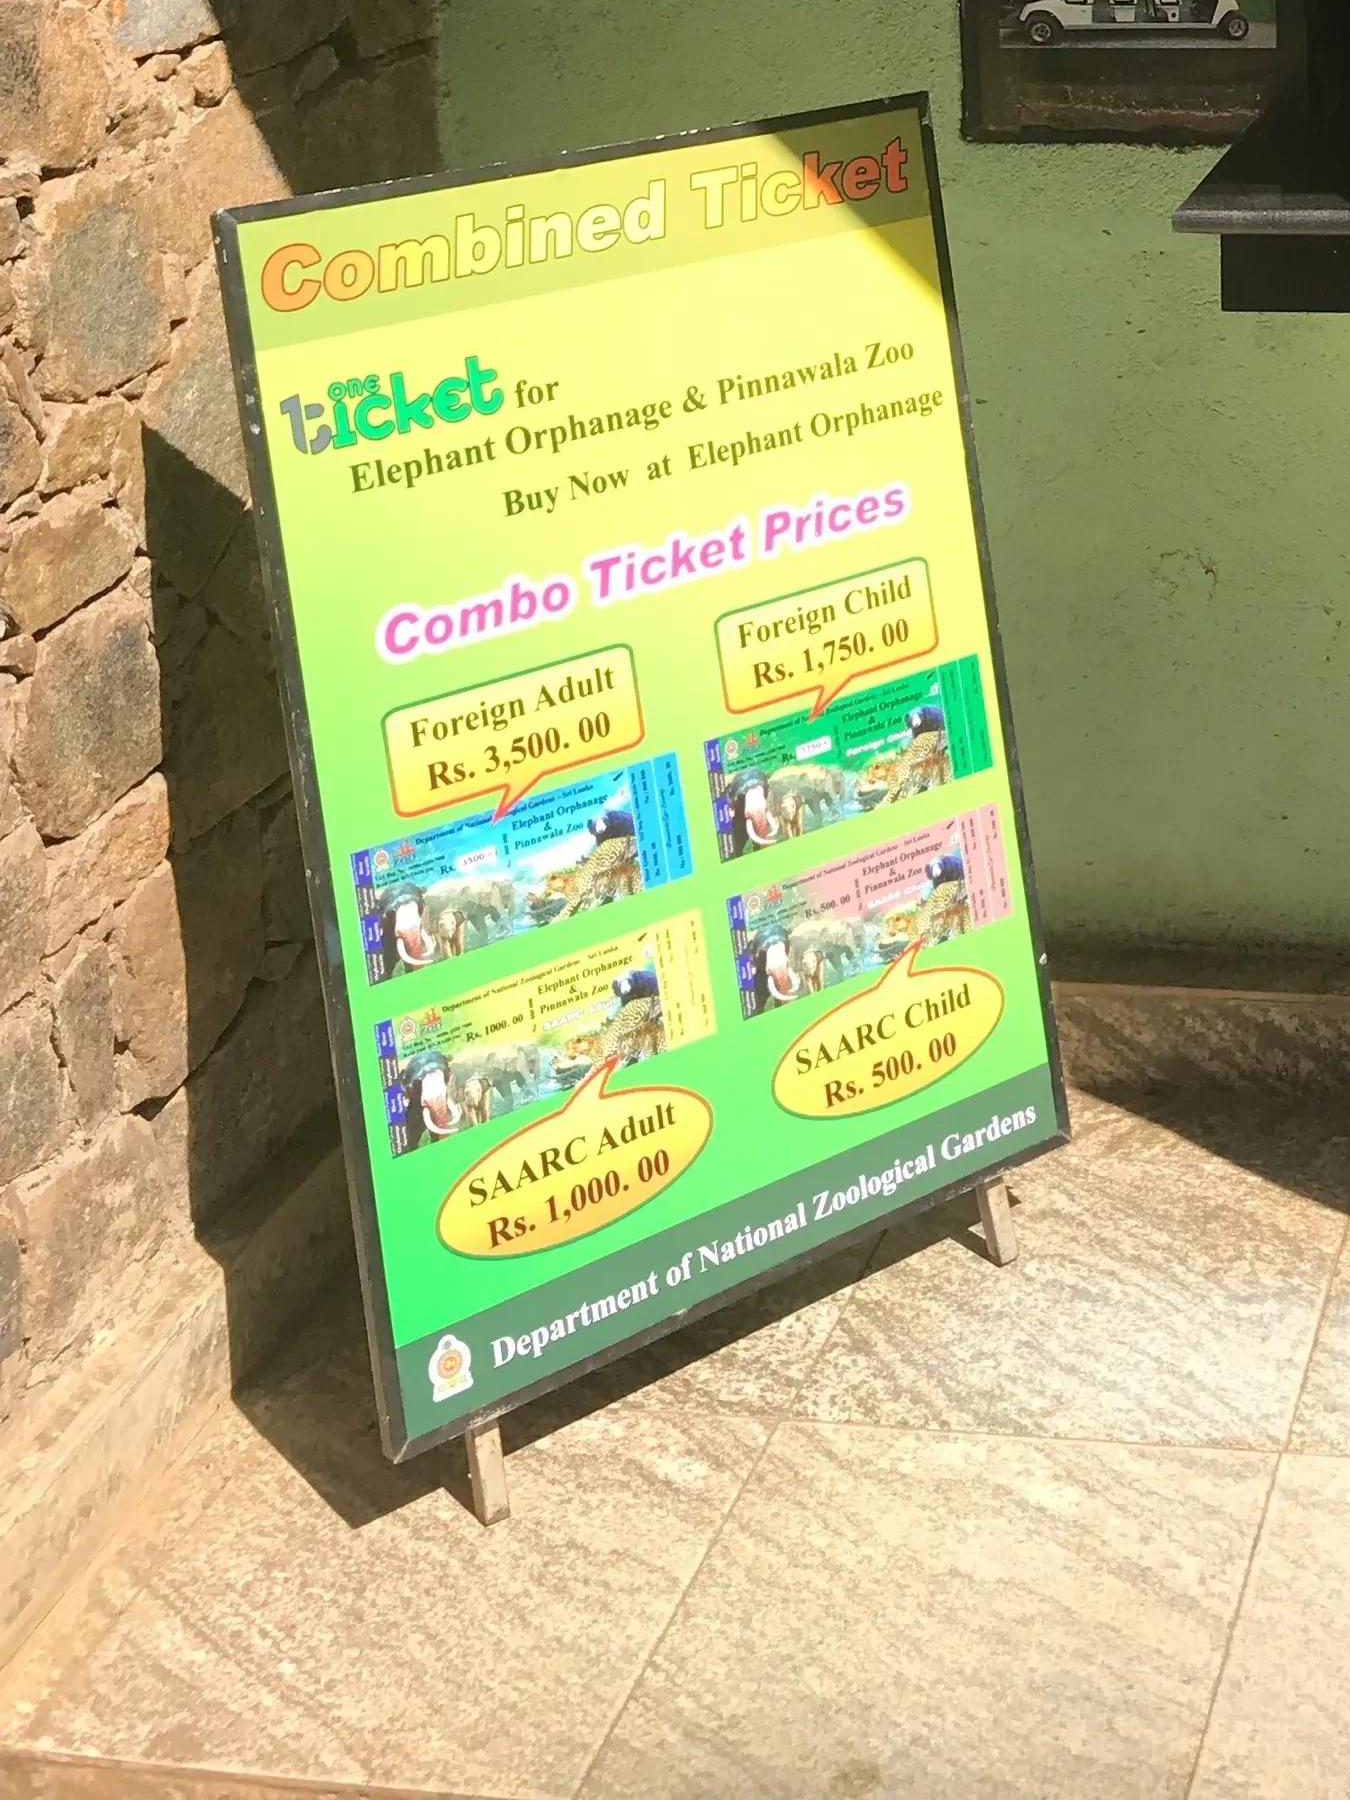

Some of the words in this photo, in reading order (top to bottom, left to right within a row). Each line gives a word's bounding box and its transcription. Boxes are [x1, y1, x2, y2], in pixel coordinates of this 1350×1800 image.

[261, 178, 667, 313] Combined
[690, 137, 909, 230] Ticket
[280, 355, 504, 455] ticket
[515, 376, 560, 408] for
[328, 374, 381, 399] one
[350, 439, 496, 494] Elephant
[506, 397, 672, 458] Orphanage
[682, 385, 708, 413] &
[716, 353, 858, 405] Pinnawala
[865, 339, 915, 370] Zoo
[503, 483, 560, 518] Buy
[569, 467, 630, 501] Now
[647, 456, 672, 482] at
[689, 418, 804, 471] Elephant
[810, 388, 943, 443] Orphanage
[384, 577, 571, 655] Combo
[591, 523, 747, 600] Ticket
[764, 486, 906, 552] Prices
[736, 601, 837, 650] Foreign
[843, 575, 913, 617] Child
[410, 694, 527, 750] Foreign
[536, 665, 616, 712] Adult
[753, 656, 795, 690] Rs.
[427, 753, 476, 792] Rs.
[566, 821, 584, 834] Zoo
[795, 1012, 897, 1077] SAARC
[903, 981, 972, 1029] Child
[823, 1075, 865, 1109] Rs.
[468, 1134, 591, 1210] SAARC
[595, 1099, 677, 1153] Adult
[487, 1212, 536, 1250] Rs.
[490, 1272, 658, 1368] Department
[665, 1260, 692, 1288] of
[699, 1200, 807, 1274] National
[812, 1142, 936, 1233] Zoological
[941, 1104, 1037, 1161] Gardens
